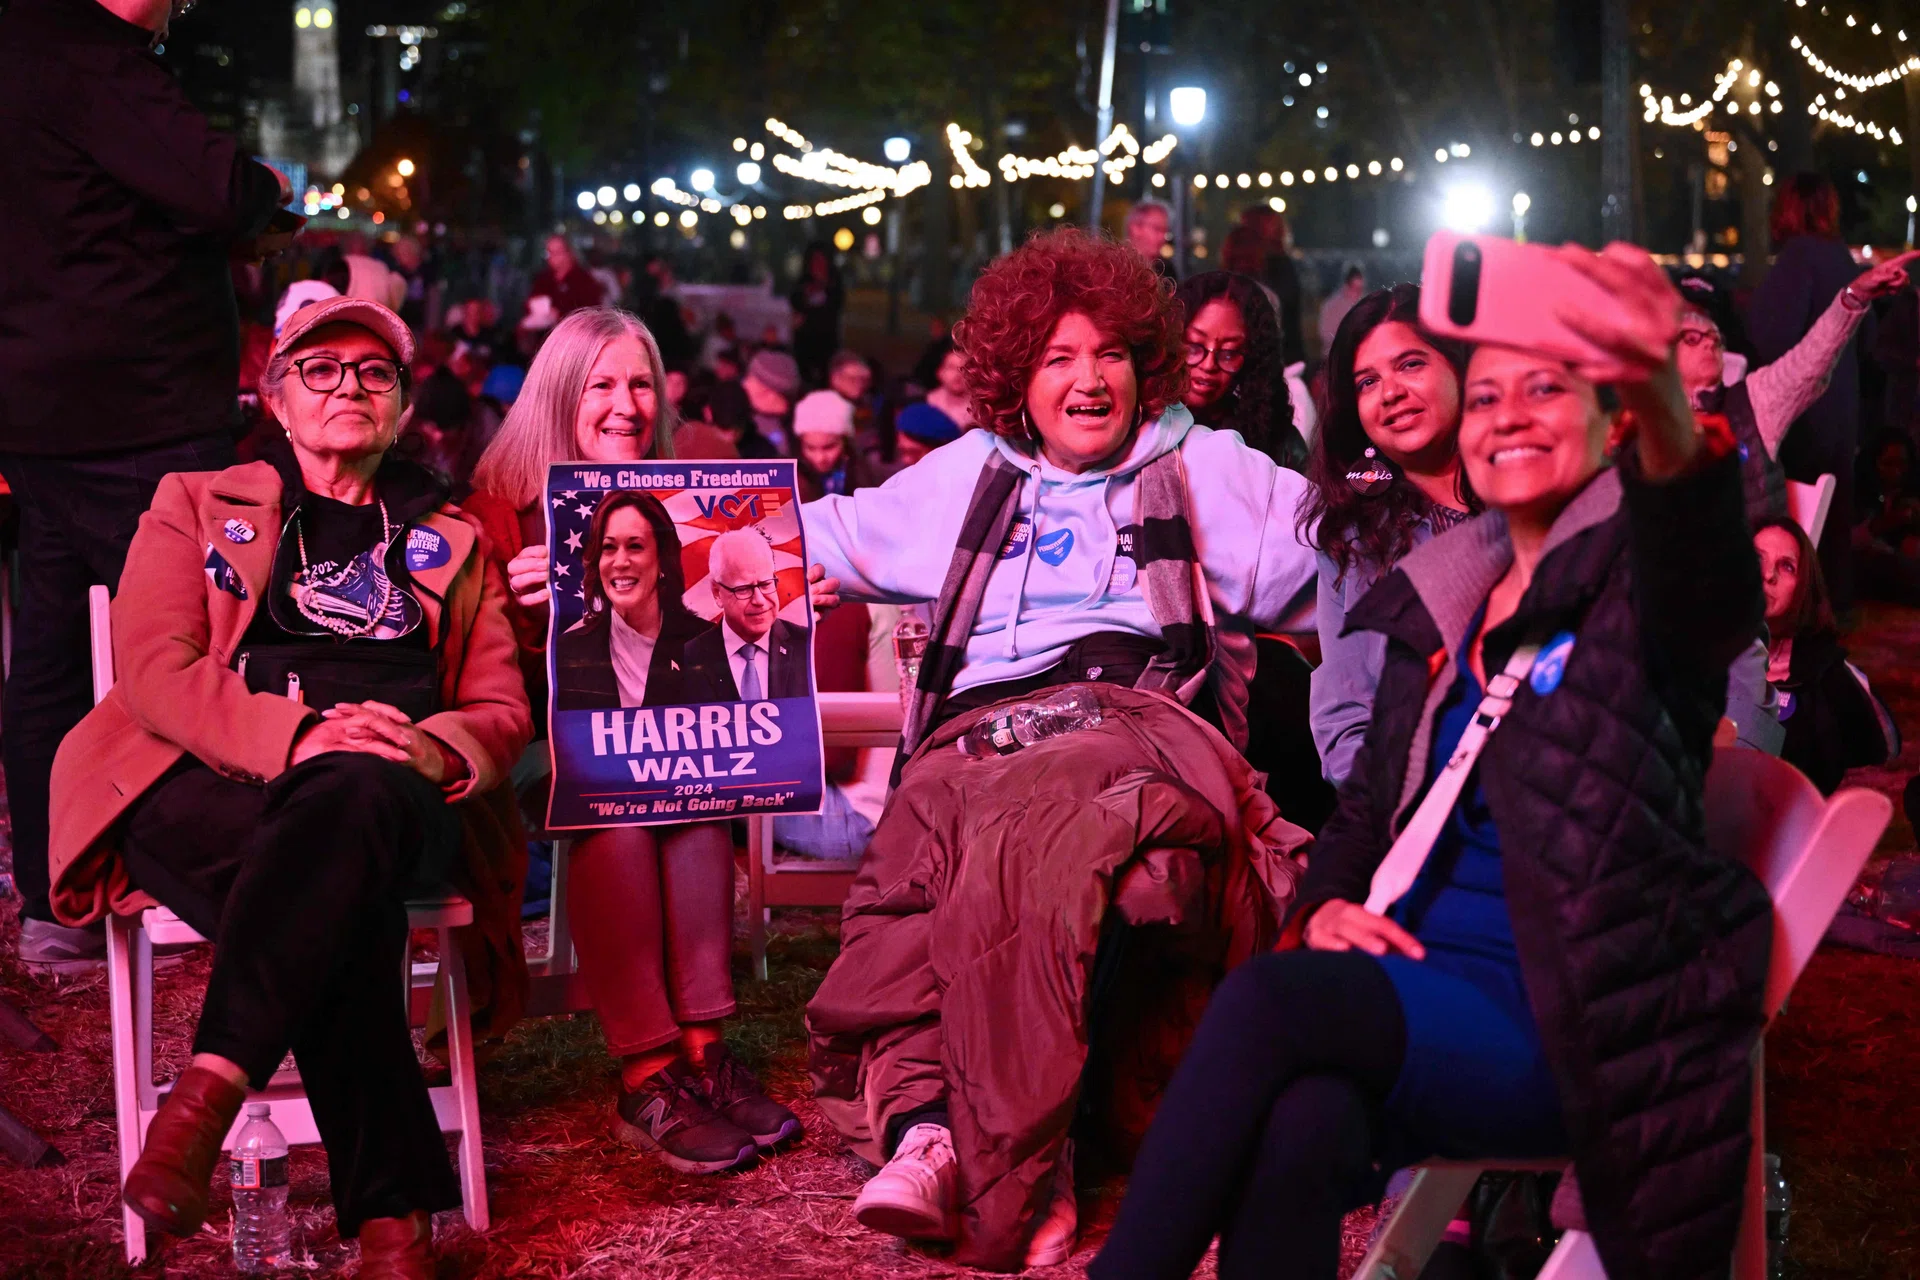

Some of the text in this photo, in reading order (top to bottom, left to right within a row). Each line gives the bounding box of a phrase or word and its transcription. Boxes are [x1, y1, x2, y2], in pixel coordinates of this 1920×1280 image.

[574, 469, 778, 488] "We Choose Freedom"
[1345, 470, 1393, 480] music
[693, 493, 783, 519] VOTE
[406, 538, 439, 552] VOTERS
[407, 529, 440, 545] JEWISH
[591, 702, 782, 756] HARRIS
[628, 752, 757, 783] WALZ
[674, 783, 714, 796] 2024
[589, 791, 794, 816] "We're Not Going Back"
